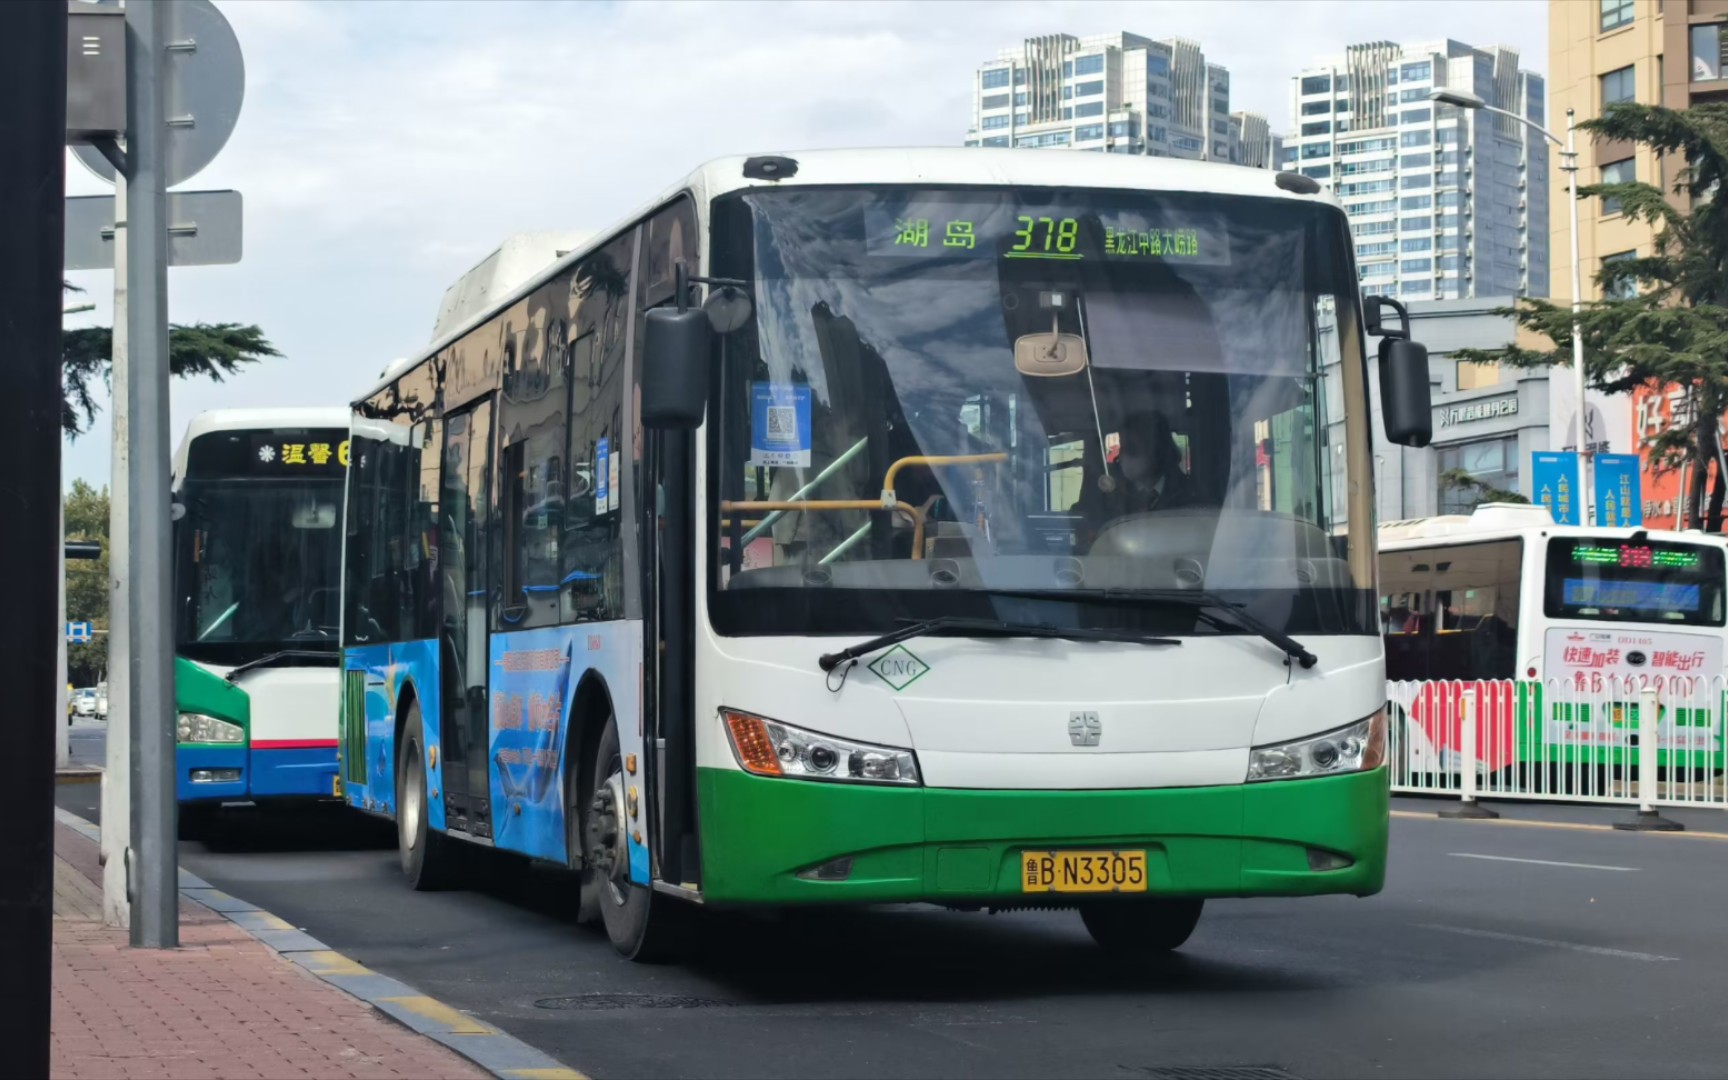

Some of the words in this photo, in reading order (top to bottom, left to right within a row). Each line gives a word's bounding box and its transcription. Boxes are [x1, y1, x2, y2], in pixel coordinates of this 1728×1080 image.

[893, 217, 977, 249] 湖岛
[1012, 216, 1078, 252] 378
[880, 659, 917, 677] CNG
[1652, 651, 1705, 671] 智能出行
